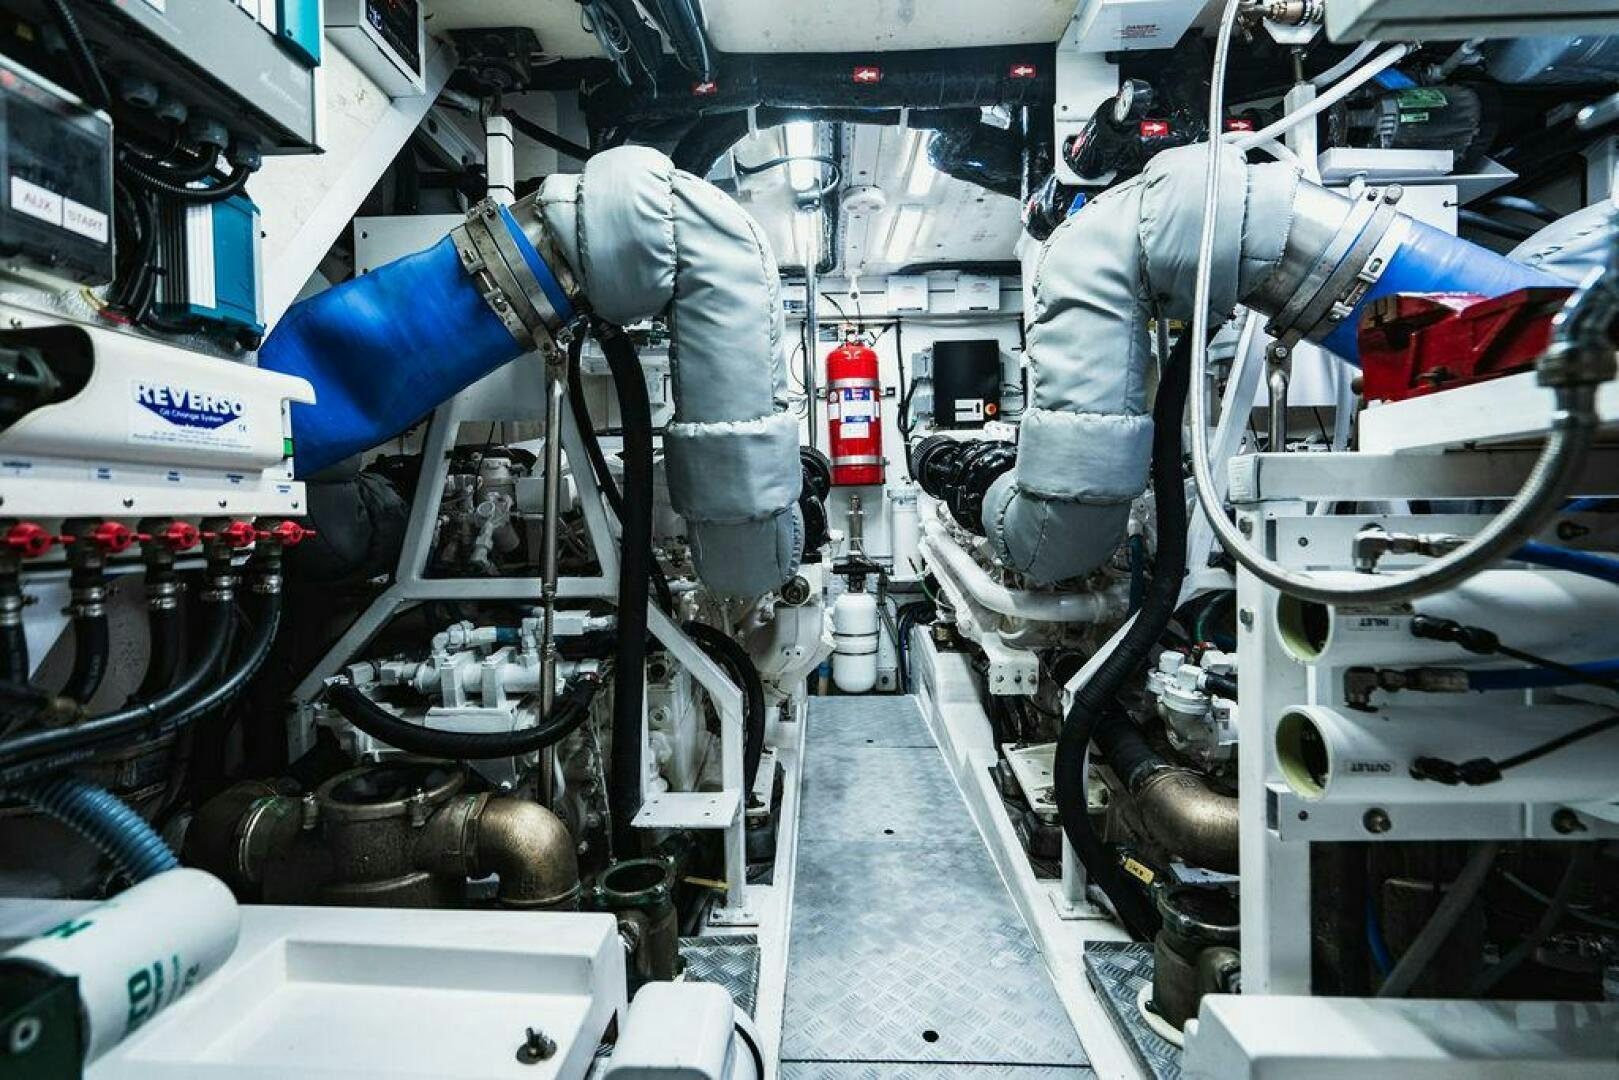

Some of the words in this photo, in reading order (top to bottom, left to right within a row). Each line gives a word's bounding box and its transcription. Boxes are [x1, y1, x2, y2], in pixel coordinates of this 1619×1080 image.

[137, 384, 244, 416] REVERSO
[172, 409, 200, 421] Change
[201, 413, 224, 423] System
[1359, 617, 1390, 627] INLET
[1350, 762, 1392, 773] OUTLET
